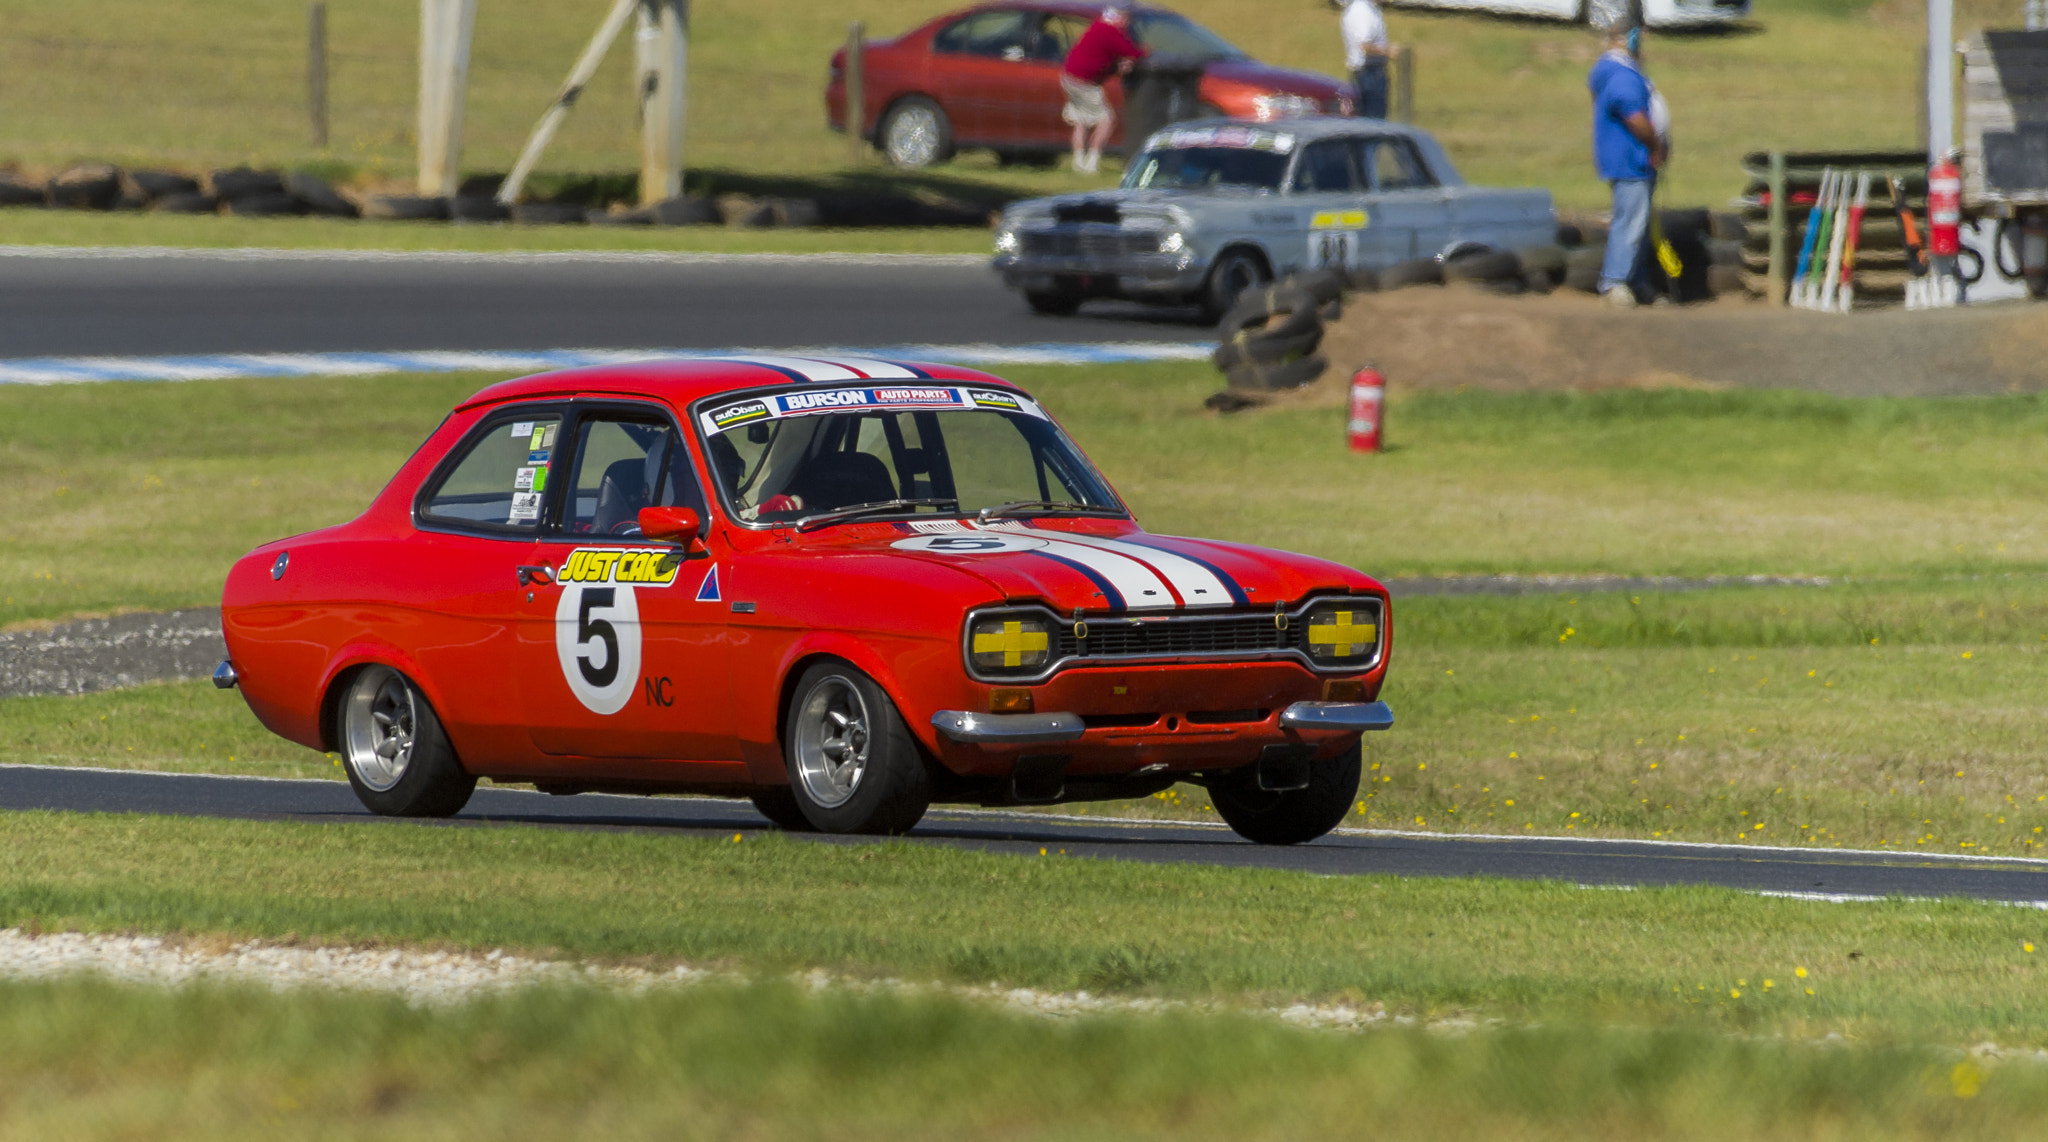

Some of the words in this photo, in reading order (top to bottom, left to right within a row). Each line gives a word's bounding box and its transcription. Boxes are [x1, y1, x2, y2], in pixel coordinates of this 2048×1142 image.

[786, 391, 867, 409] BURSON
[880, 391, 910, 399] AUTO
[910, 390, 948, 399] PARTS
[926, 537, 1006, 550] 5
[558, 551, 621, 582] JUST
[576, 587, 619, 688] 5
[645, 676, 674, 707] NC
